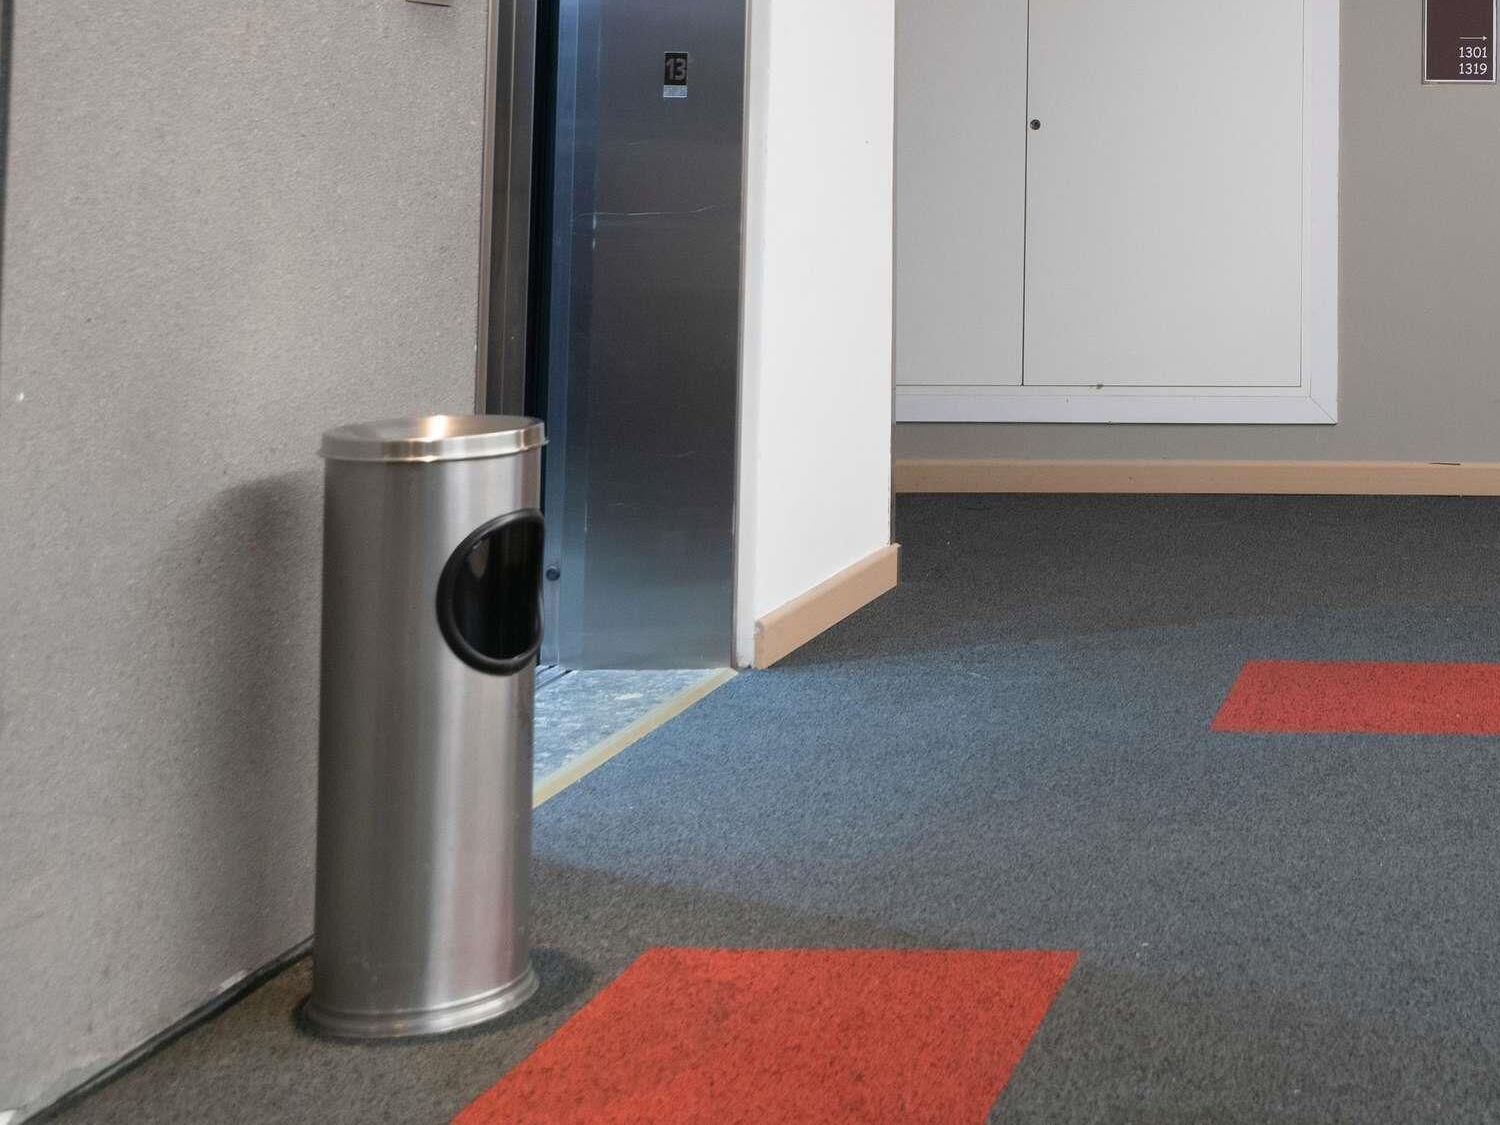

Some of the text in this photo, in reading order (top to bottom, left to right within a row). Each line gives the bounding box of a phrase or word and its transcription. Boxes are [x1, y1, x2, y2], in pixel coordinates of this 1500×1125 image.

[1459, 46, 1488, 58] 1301
[666, 58, 687, 80] 13
[1459, 62, 1488, 75] 1319
